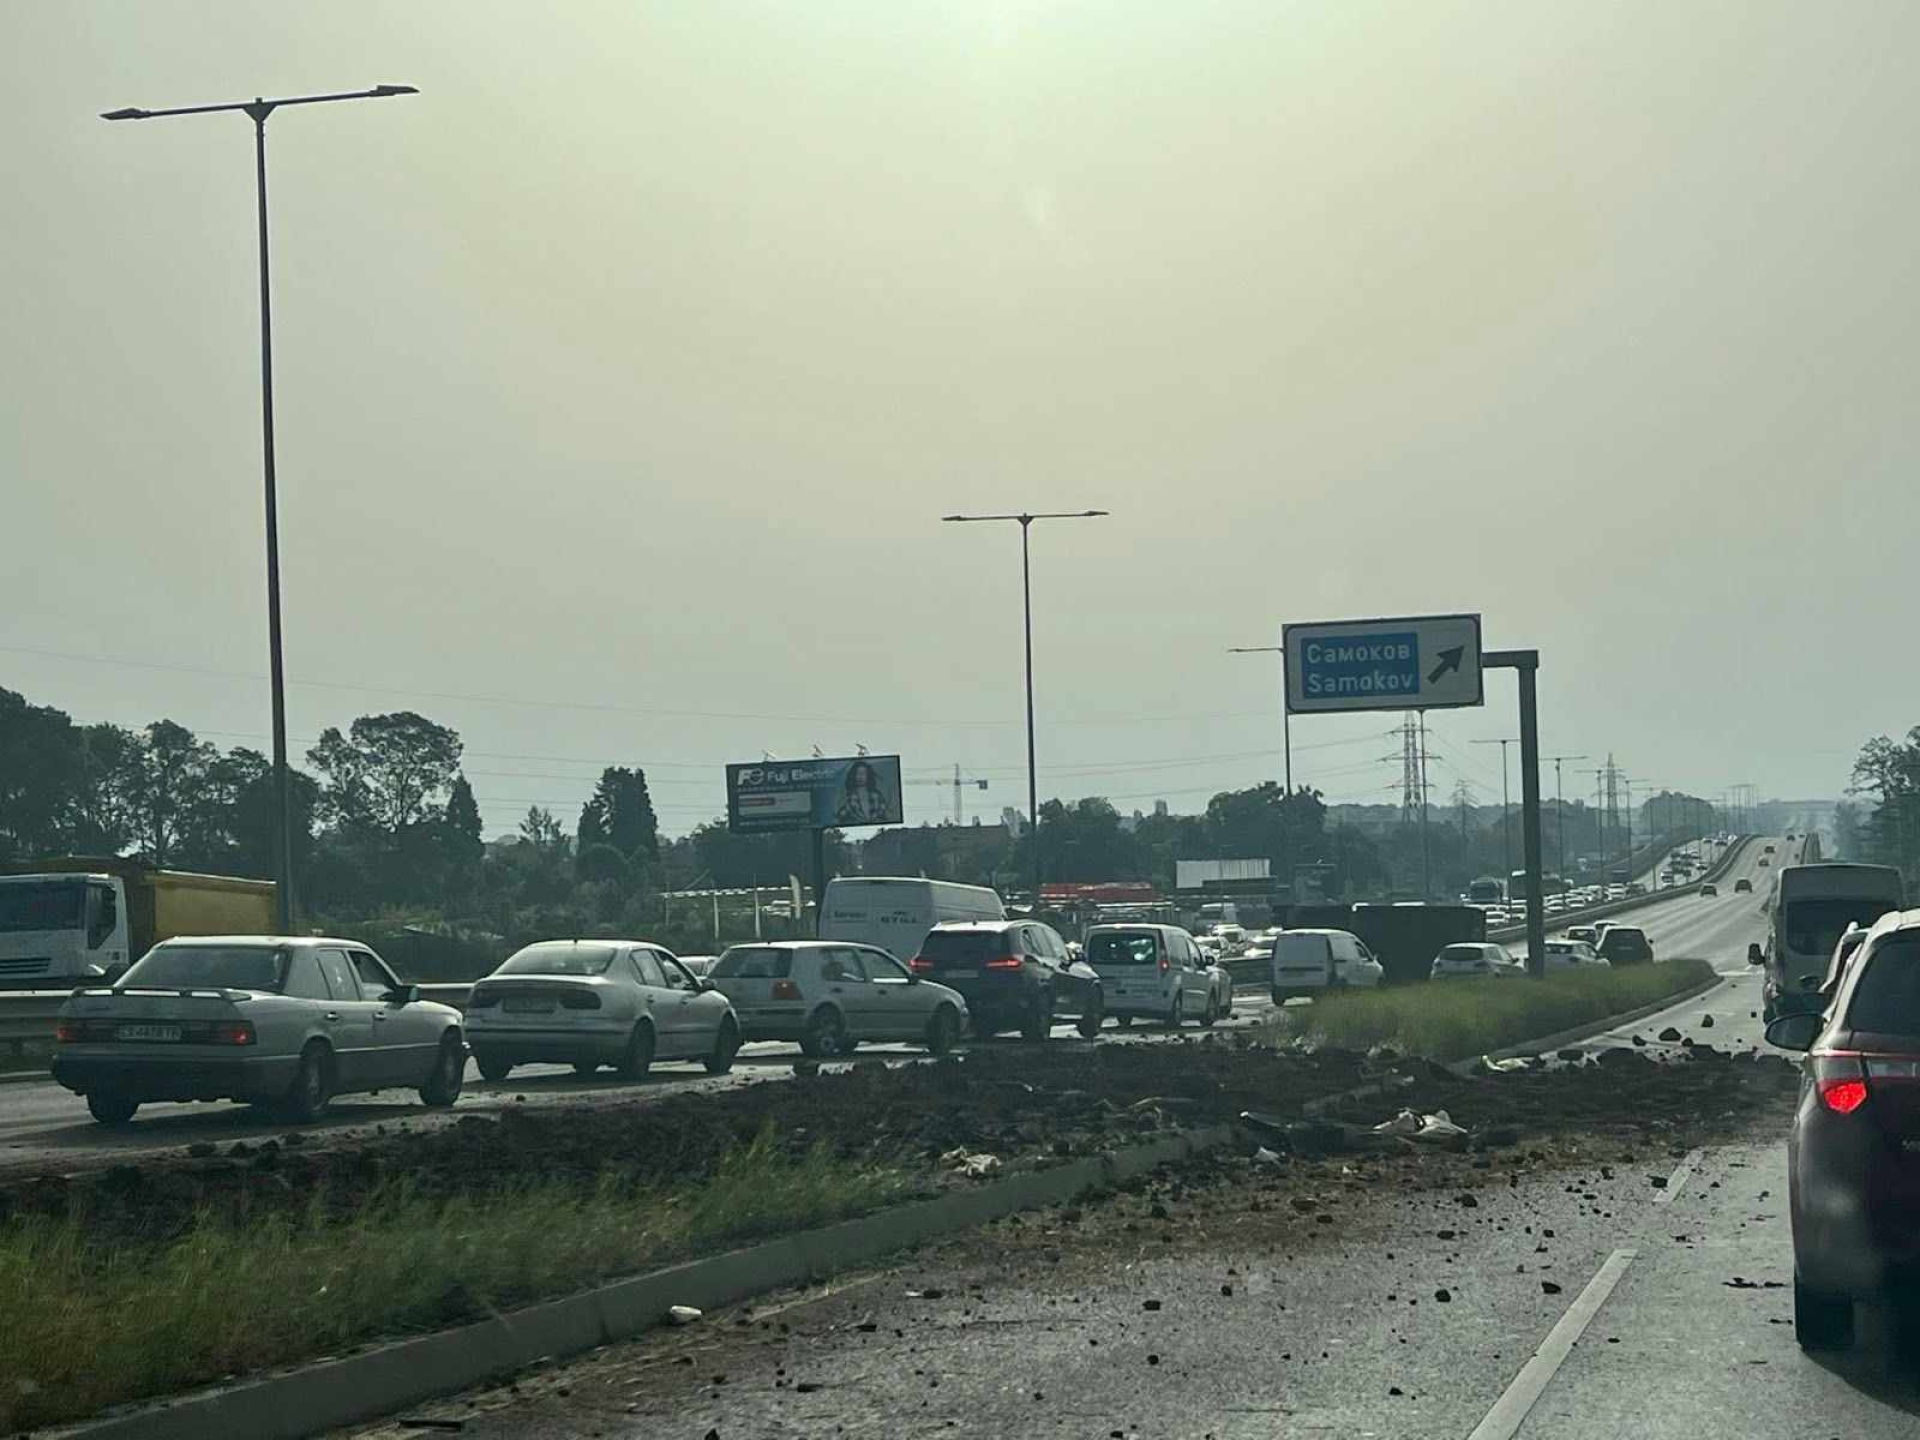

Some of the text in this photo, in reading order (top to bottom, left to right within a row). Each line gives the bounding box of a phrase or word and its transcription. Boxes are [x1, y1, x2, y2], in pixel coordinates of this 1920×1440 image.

[1306, 644, 1411, 663] Самоков
[1307, 670, 1413, 693] Samokov
[767, 770, 788, 784] Fuji
